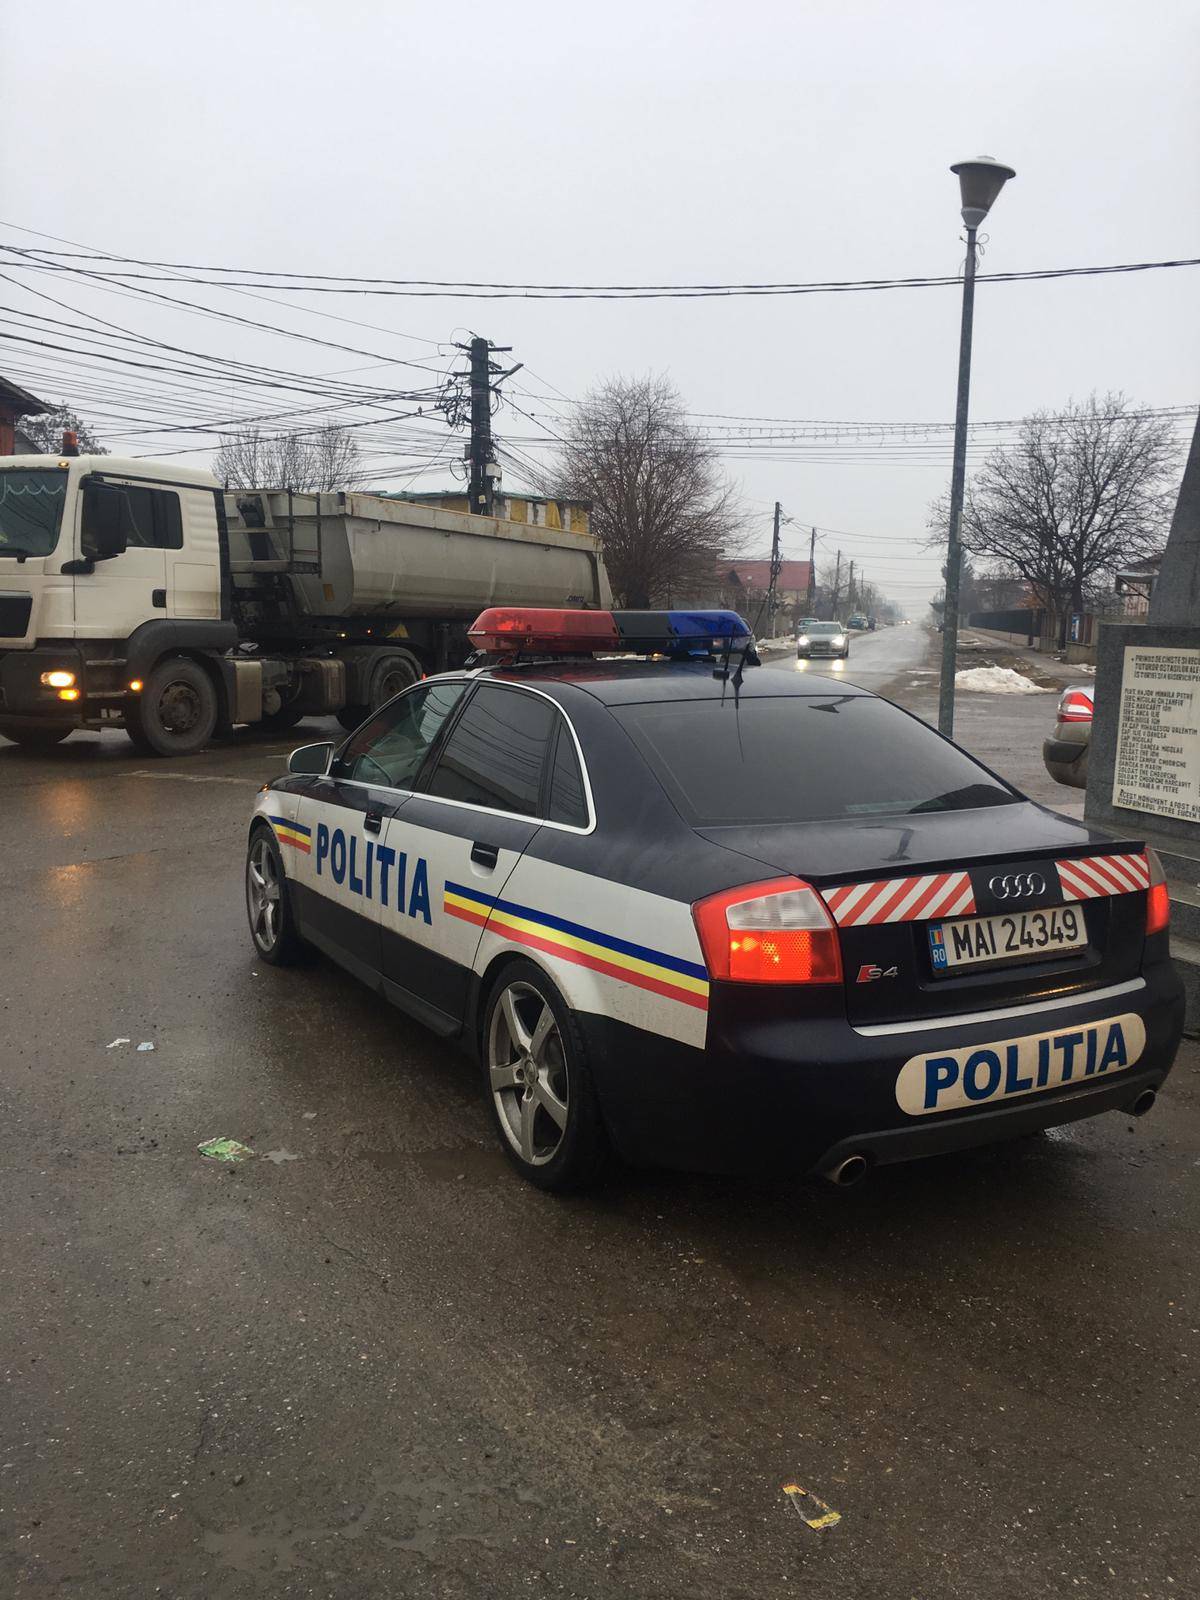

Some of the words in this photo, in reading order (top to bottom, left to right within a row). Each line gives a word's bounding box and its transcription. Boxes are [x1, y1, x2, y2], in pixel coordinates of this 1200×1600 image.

[316, 822, 433, 926] POLITIA
[932, 947, 946, 963] RO
[951, 920, 997, 960] MAI
[1001, 908, 1079, 952] 24349
[866, 965, 899, 980] S4
[923, 1022, 1128, 1109] POLITIA
